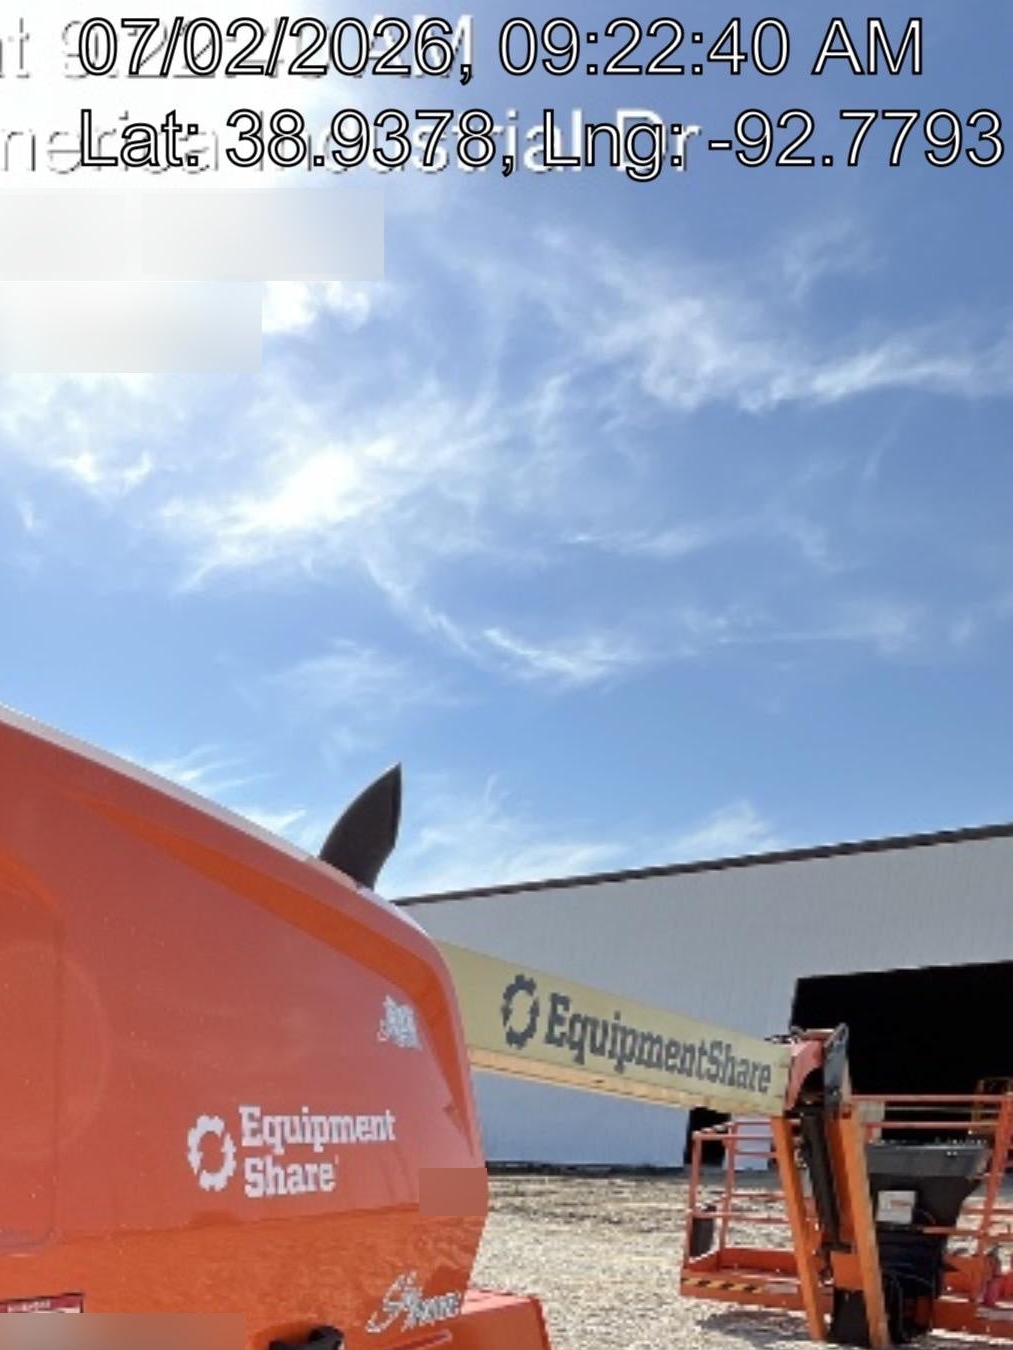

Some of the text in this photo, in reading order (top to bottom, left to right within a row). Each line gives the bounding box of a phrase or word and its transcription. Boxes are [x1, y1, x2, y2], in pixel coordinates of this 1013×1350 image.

[544, 992, 772, 1095] EquipmentShare
[238, 1104, 396, 1154] Equipment
[243, 1157, 337, 1199] Share
